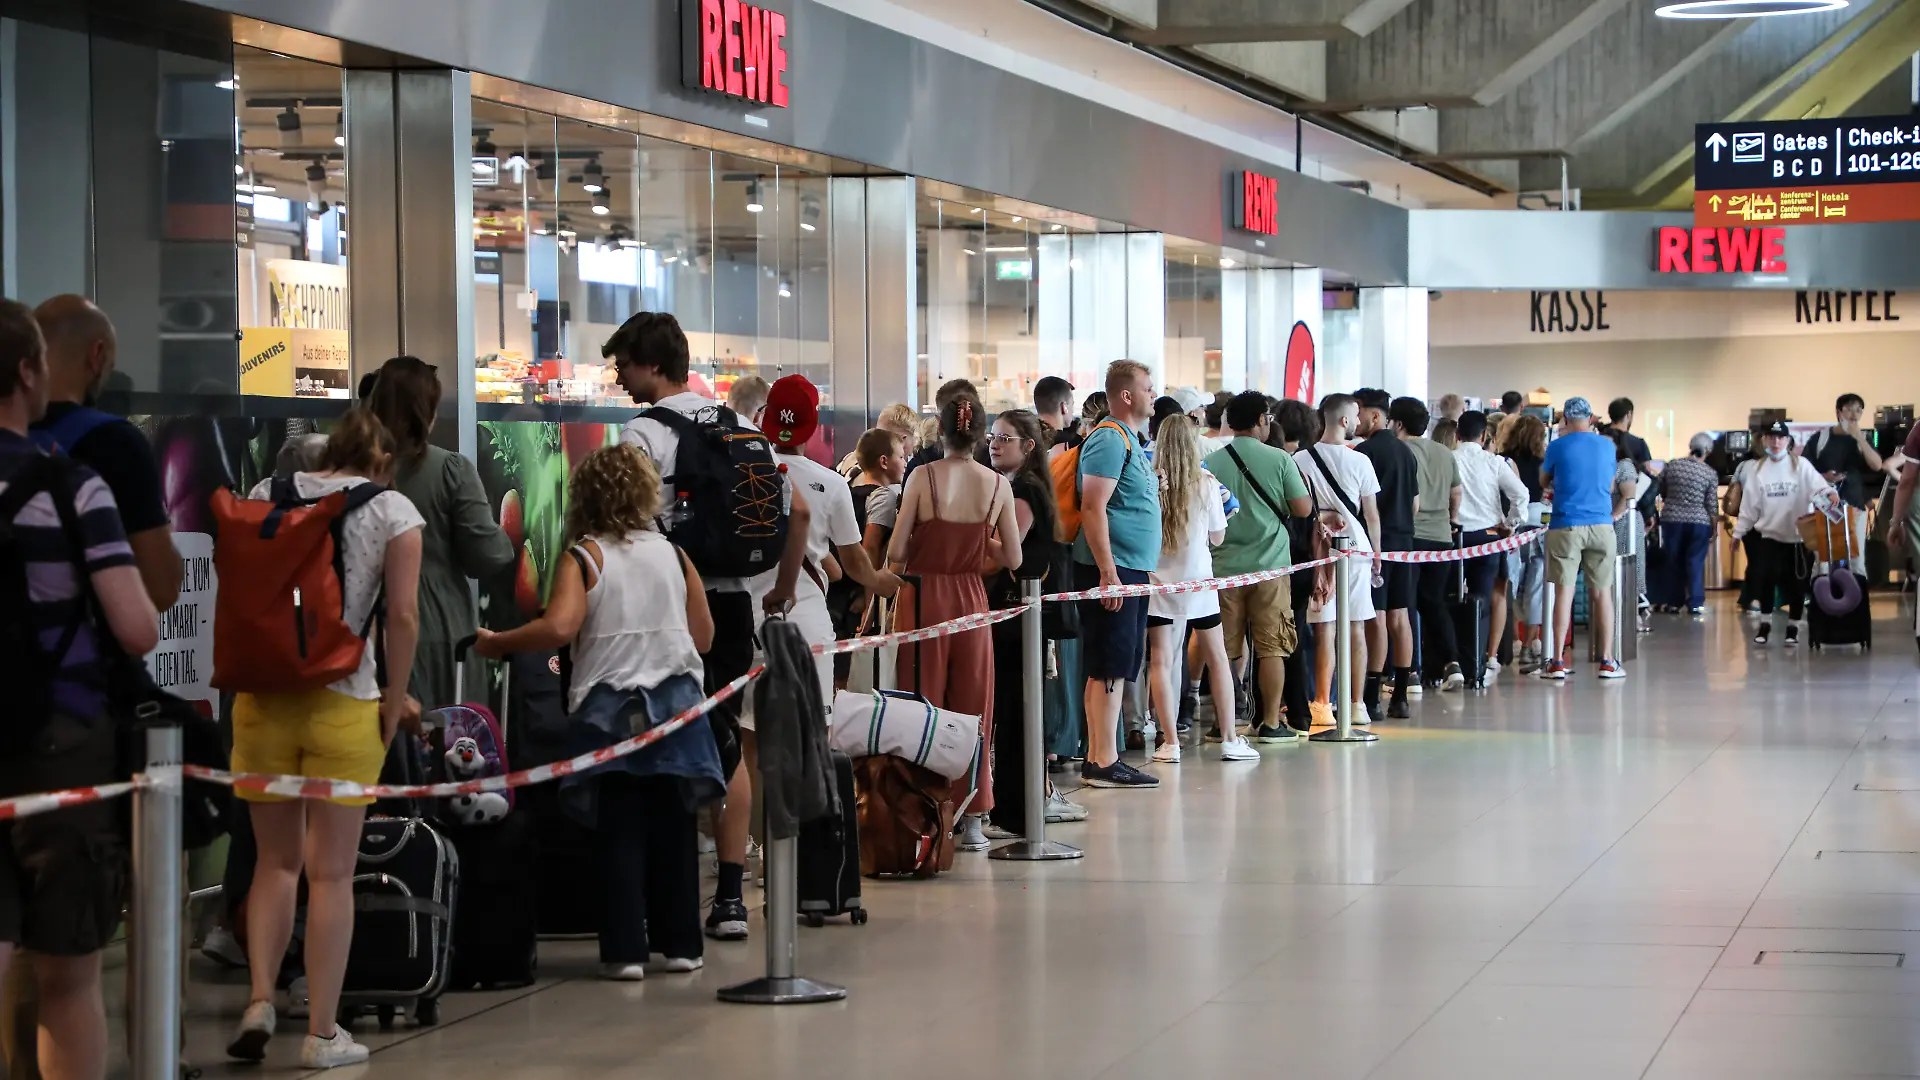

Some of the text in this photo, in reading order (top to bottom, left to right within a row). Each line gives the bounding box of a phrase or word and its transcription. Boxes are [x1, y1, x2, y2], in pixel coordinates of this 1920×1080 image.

[700, 0, 788, 108] REWE
[1773, 133, 1828, 151] Gates
[1773, 158, 1823, 178] B C D
[1848, 152, 1920, 172] 101-126
[1245, 170, 1278, 236] REWE
[1780, 191, 1815, 199] Konferenz-
[1780, 205, 1814, 213] Conference
[1821, 192, 1849, 202] Hotels
[1659, 226, 1787, 273] REWE
[1531, 290, 1610, 332] KASSE
[240, 341, 286, 376] OUVENIRS
[303, 344, 313, 360] Aus
[332, 345, 348, 365] Regio
[179, 557, 210, 592] IE VOM
[181, 649, 199, 685] TAG.
